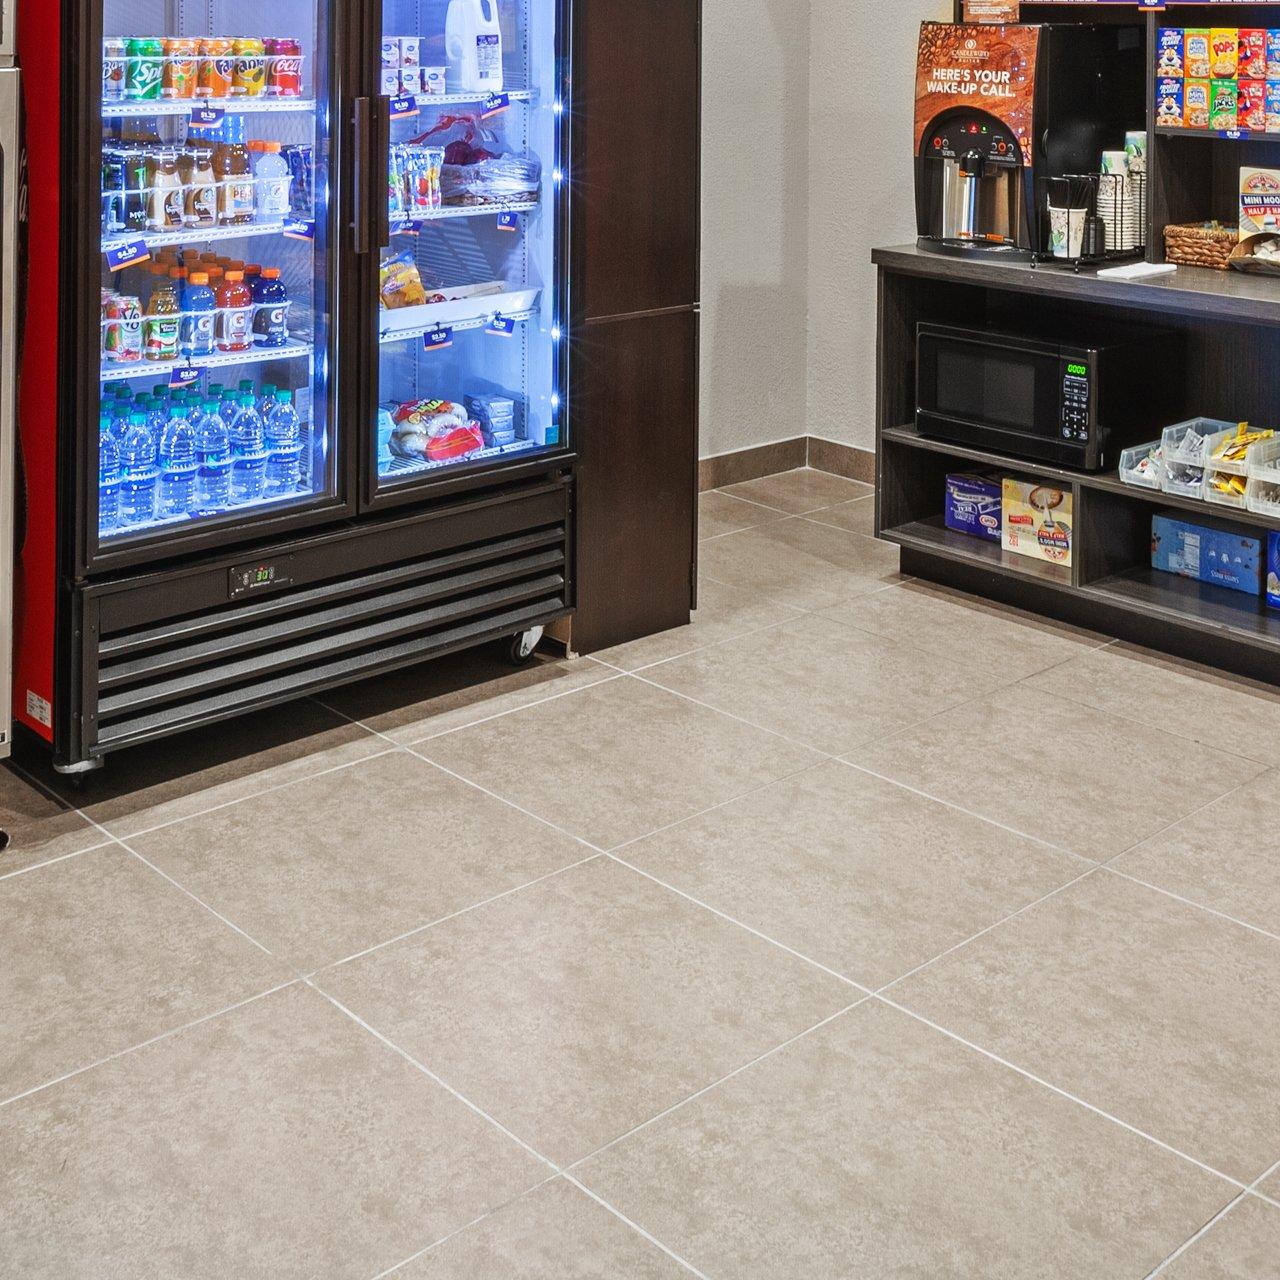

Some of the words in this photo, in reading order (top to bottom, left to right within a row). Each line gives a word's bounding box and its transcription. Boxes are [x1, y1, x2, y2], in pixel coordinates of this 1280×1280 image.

[1213, 41, 1235, 57] POPS
[932, 68, 970, 81] HERE'S
[973, 70, 1011, 84] YOUR
[926, 81, 978, 95] WAKE-UP
[980, 83, 1016, 98] CALL.
[1243, 195, 1263, 205] MINI
[1247, 207, 1265, 215] HALF
